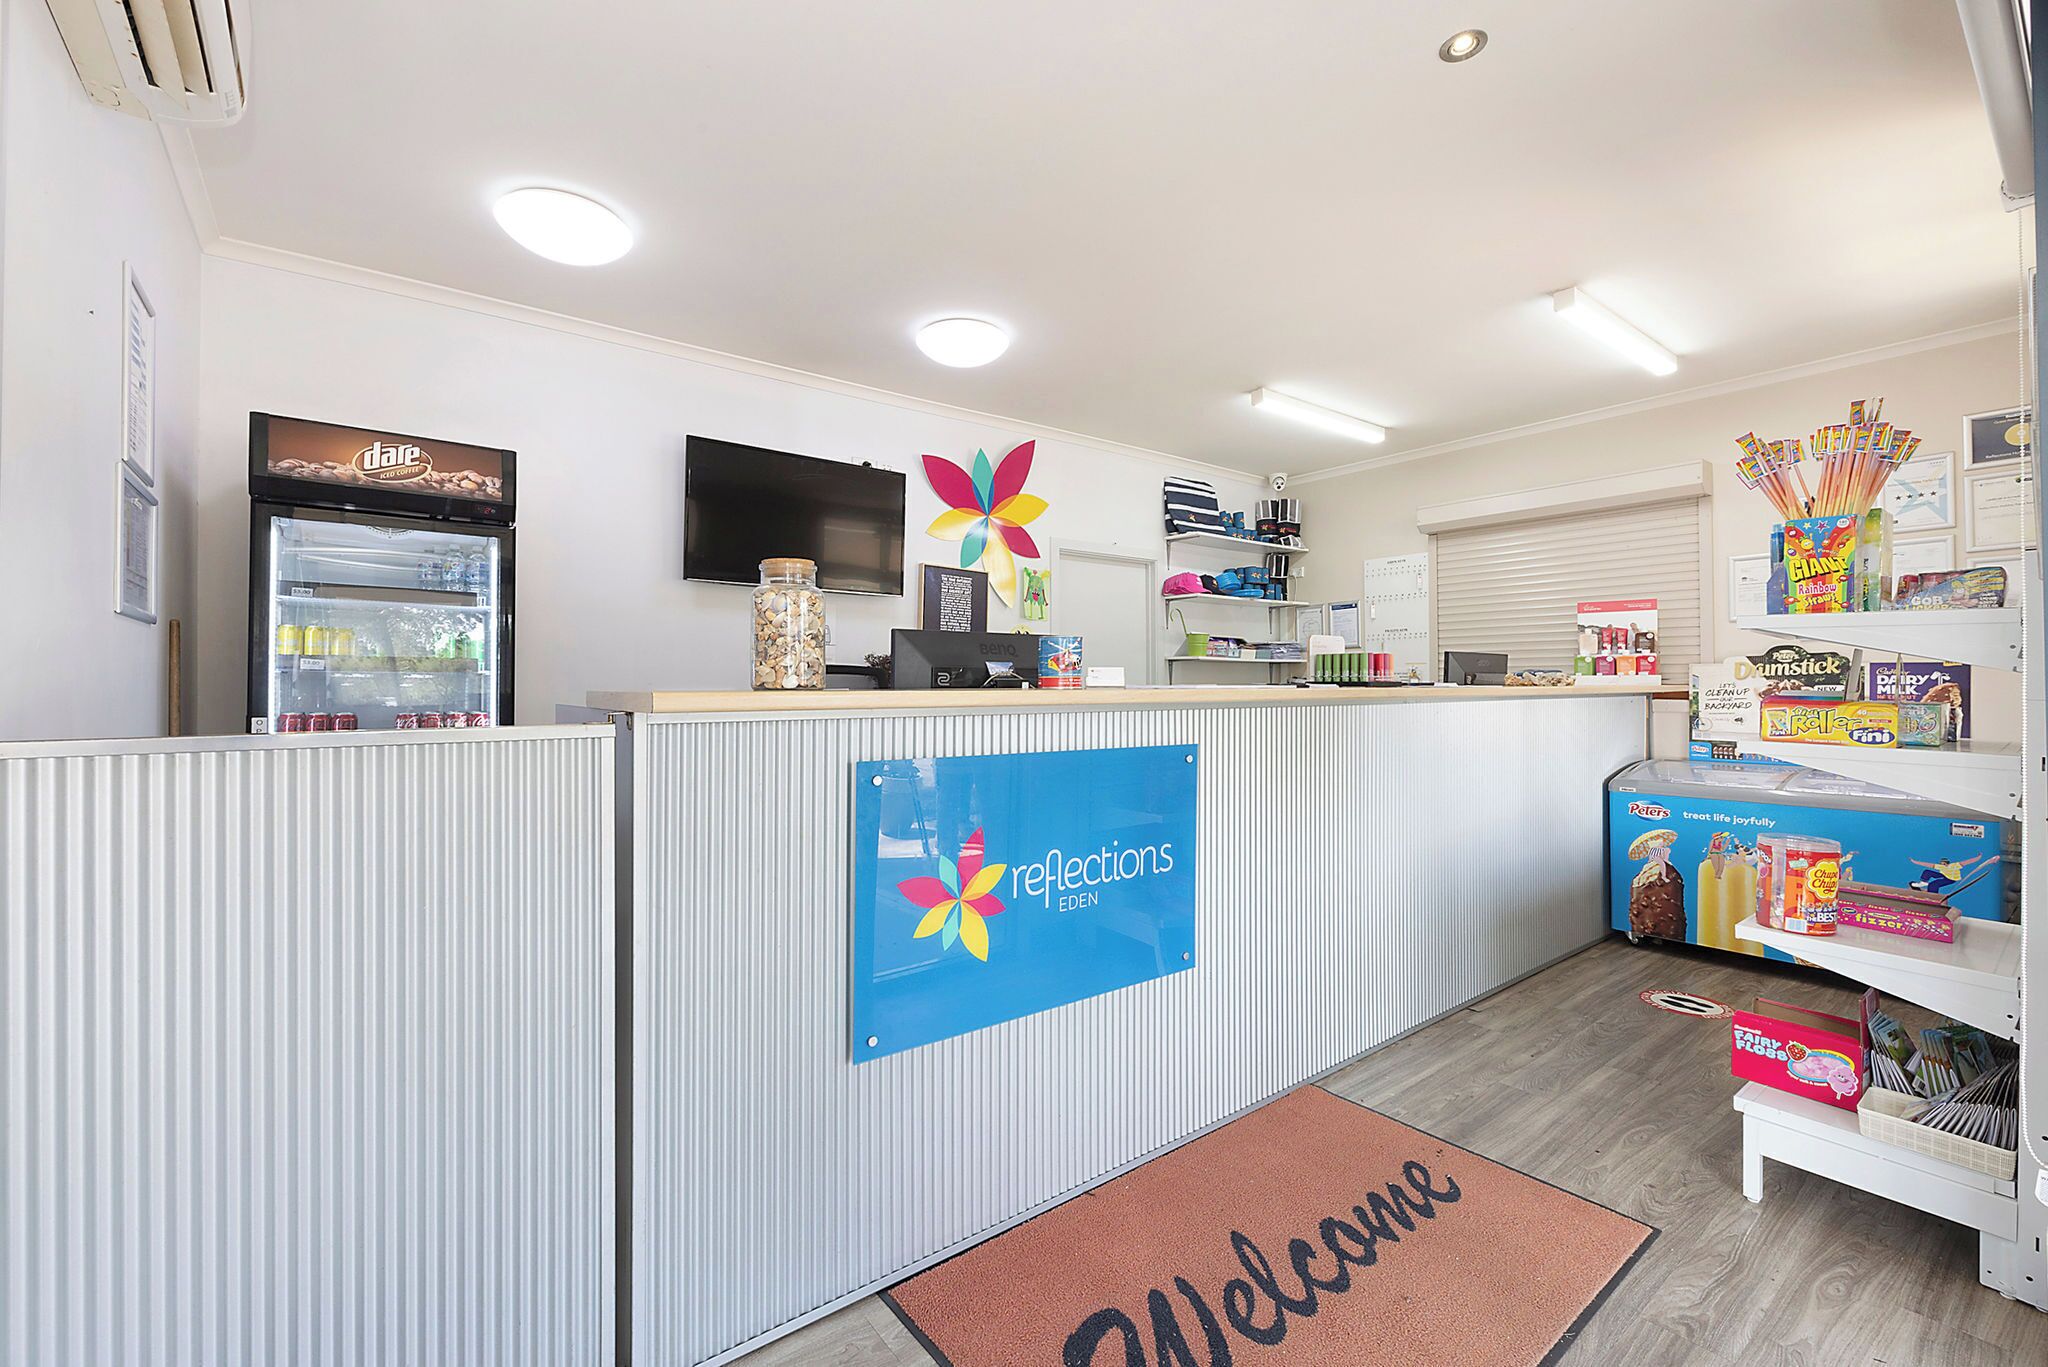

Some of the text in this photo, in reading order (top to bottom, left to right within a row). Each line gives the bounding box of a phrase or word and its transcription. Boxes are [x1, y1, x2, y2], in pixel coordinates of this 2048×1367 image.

[363, 442, 421, 470] dare
[1789, 557, 1849, 582] GIANT
[1798, 581, 1837, 594] Rainbow
[1803, 593, 1837, 607] Straws
[1734, 656, 1841, 681] Drumstick
[1877, 675, 1930, 686] DAIRY
[1705, 689, 1735, 697] CLEAN
[1877, 685, 1918, 695] MILK
[1704, 701, 1752, 710] BACKYARD
[1790, 708, 1862, 737] Roller
[1852, 730, 1891, 743] Fini
[1628, 802, 1670, 819] Peters
[1683, 811, 1776, 828] treat life joyfully
[1012, 840, 1174, 909] reflections
[1058, 891, 1099, 912] EDEN
[1855, 913, 1903, 929] fizzer
[1733, 1029, 1782, 1050] FAIRY
[1735, 1039, 1789, 1062] FLOSS
[1062, 1160, 1461, 1367] Welcome
